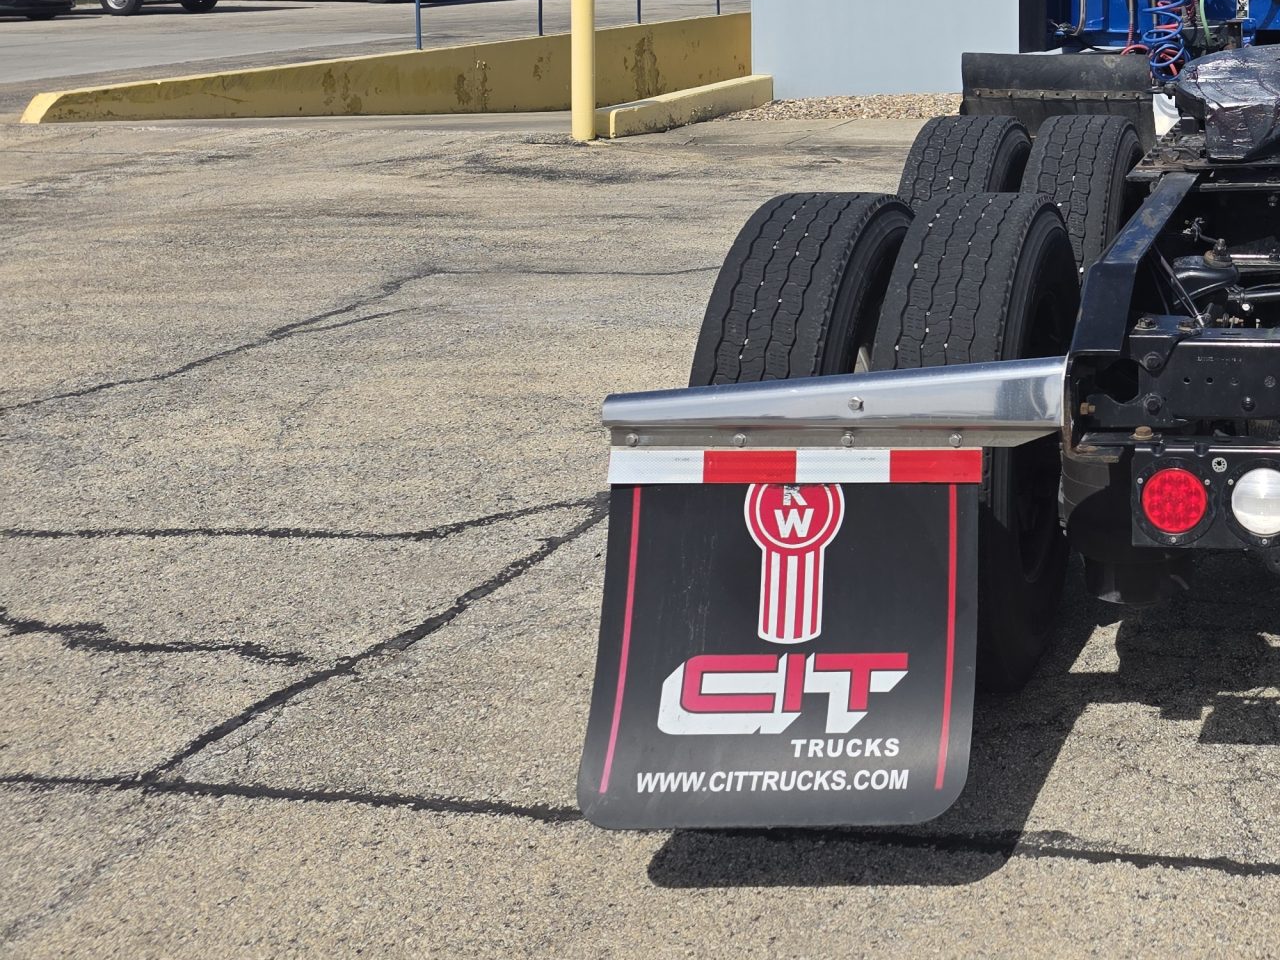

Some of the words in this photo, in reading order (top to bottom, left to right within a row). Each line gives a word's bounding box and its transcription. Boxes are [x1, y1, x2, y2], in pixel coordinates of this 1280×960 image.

[658, 652, 909, 735] CIT
[790, 738, 901, 758] TRUCKS
[636, 769, 910, 793] WWW.CITTRUCKS.COM
